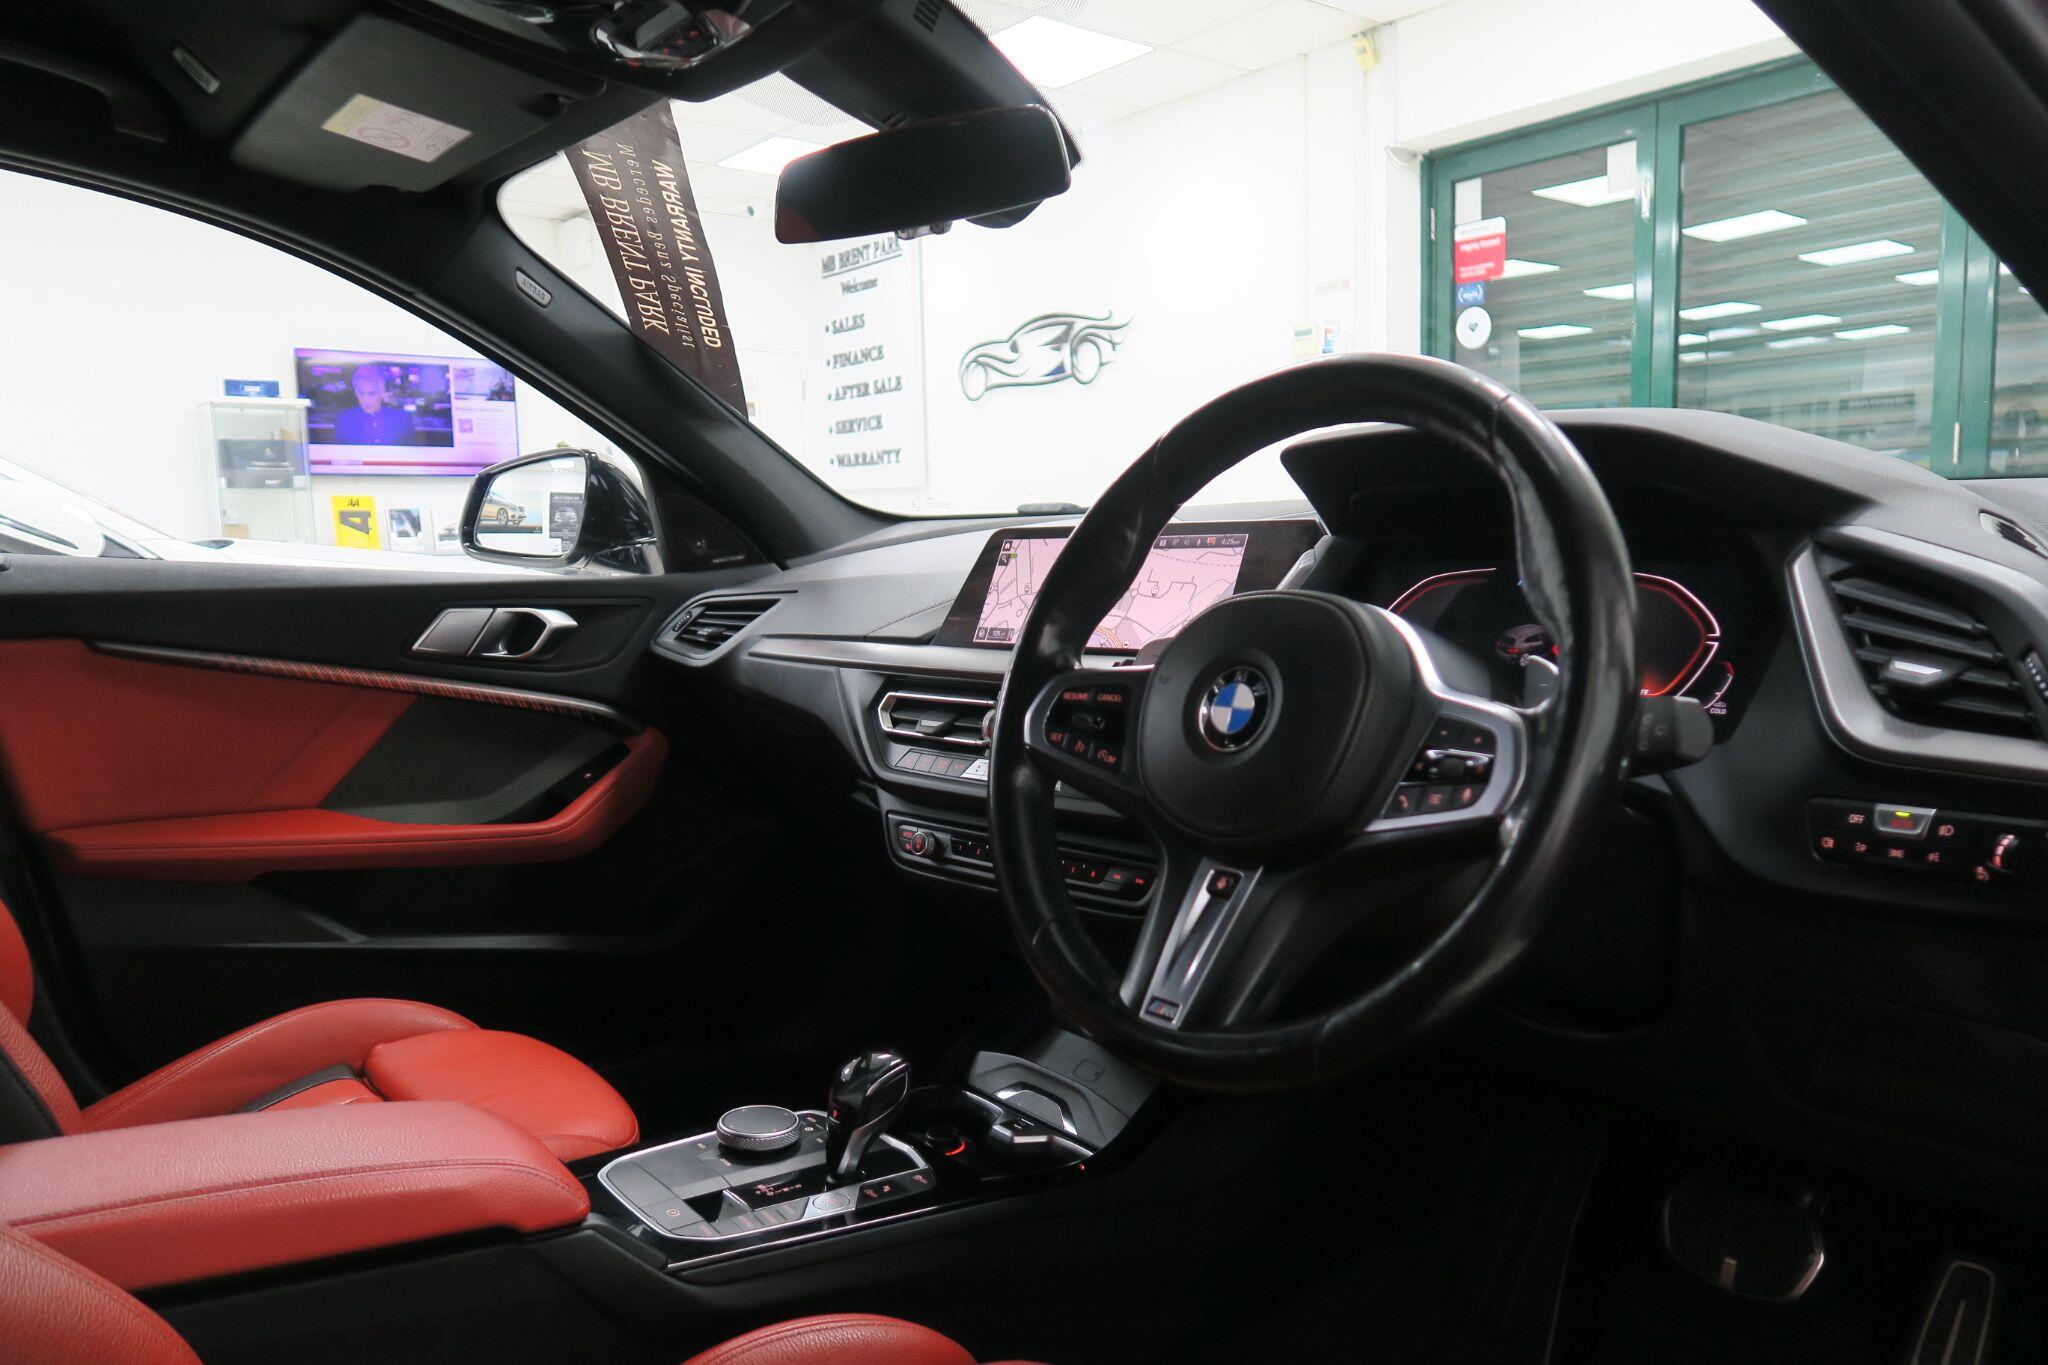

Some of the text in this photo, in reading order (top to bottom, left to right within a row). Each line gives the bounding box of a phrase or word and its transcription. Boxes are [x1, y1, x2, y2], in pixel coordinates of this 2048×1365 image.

[821, 255, 836, 273] MB
[838, 243, 871, 269] BRENT
[840, 278, 878, 296] Welcome
[832, 313, 865, 335] SALES
[832, 345, 884, 369] FINANCE
[833, 376, 902, 401] AFTER SALE
[835, 414, 883, 434] SERVICE
[836, 448, 902, 468] WARRANTY
[1847, 814, 1865, 823] OFF
